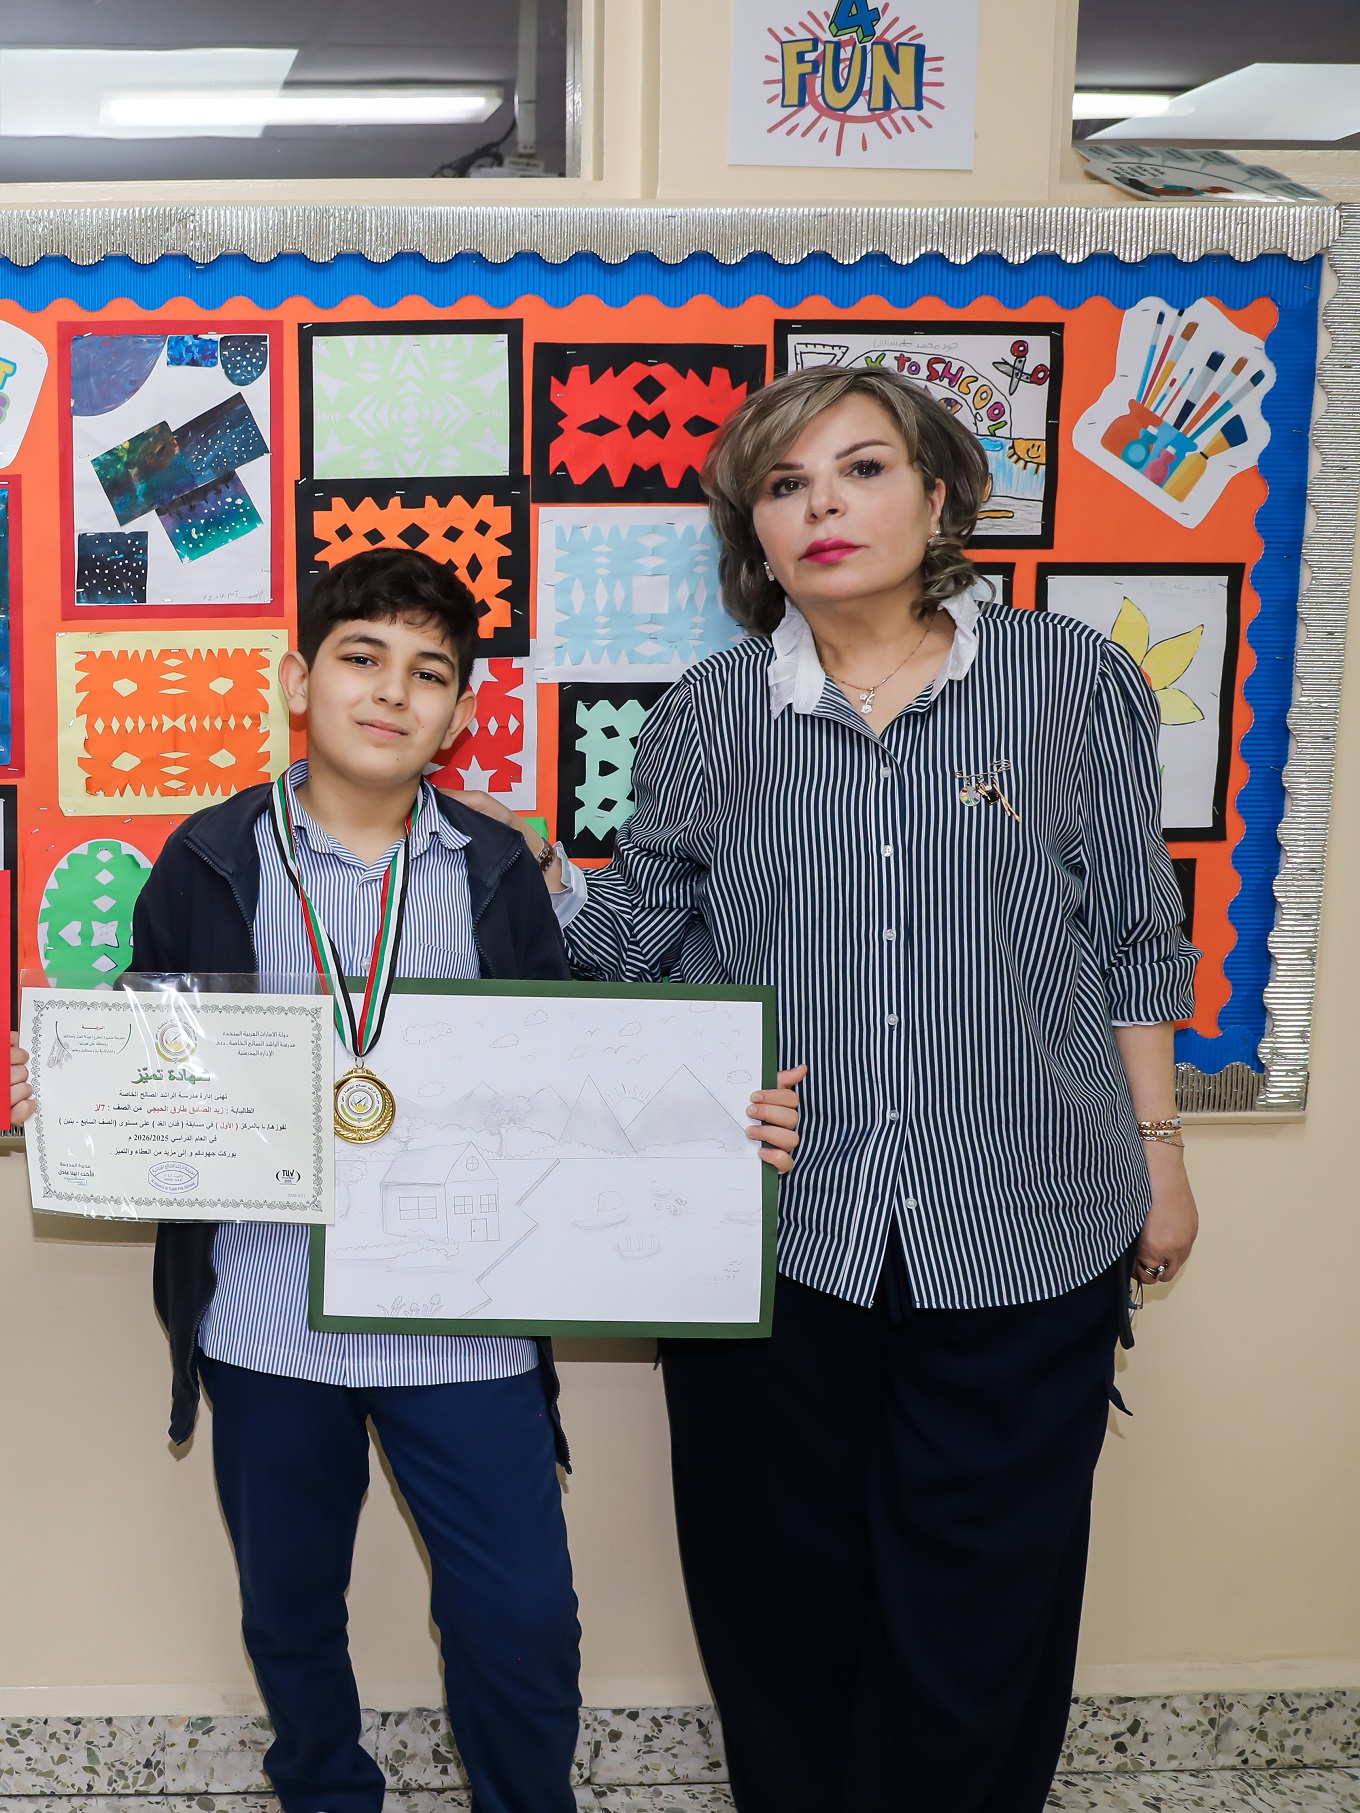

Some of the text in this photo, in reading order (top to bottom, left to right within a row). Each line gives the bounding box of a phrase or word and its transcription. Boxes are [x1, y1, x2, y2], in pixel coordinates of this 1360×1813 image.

[829, 0, 880, 44] 4
[781, 38, 925, 111] FUN
[140, 1092, 157, 1100] الصالح
[160, 1092, 176, 1100] الراشد
[178, 1092, 198, 1100] مدرسة
[170, 1106, 187, 1114] طارق
[186, 1121, 204, 1129] مسابقة
[206, 1122, 214, 1130] في
[209, 1136, 217, 1144] في
[164, 1149, 176, 1157] مزيد
[195, 1150, 216, 1158] جهودكم
[218, 1150, 236, 1158] بوركت
